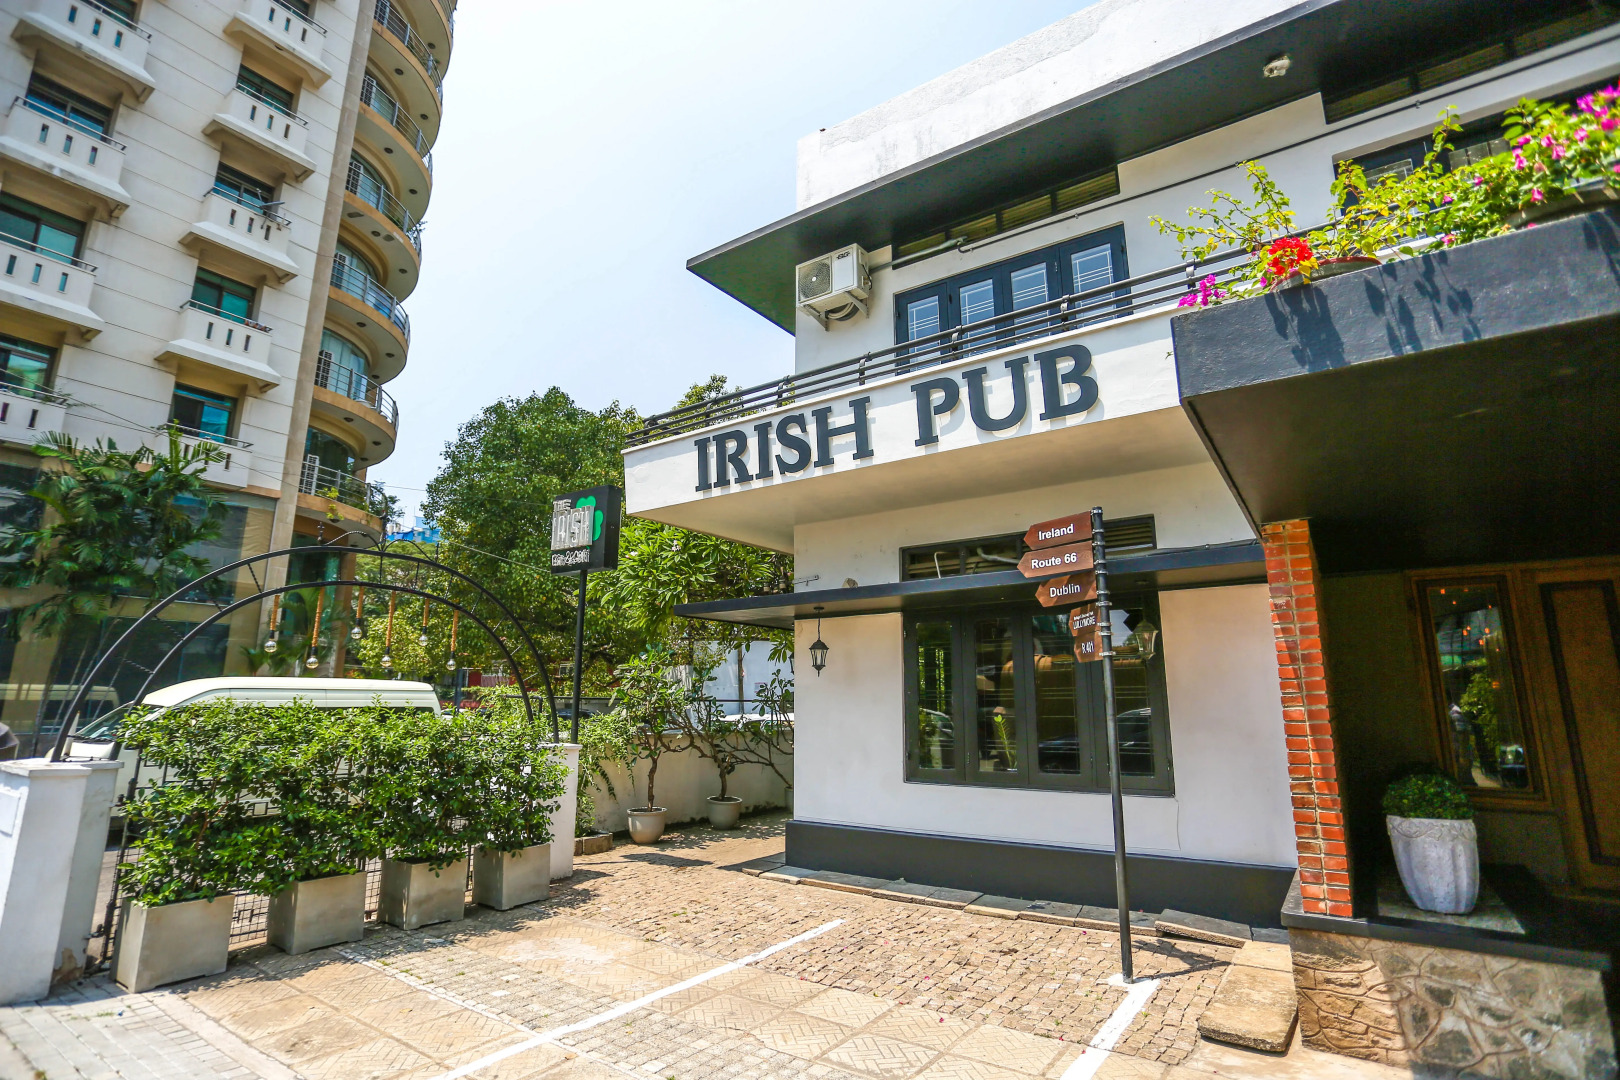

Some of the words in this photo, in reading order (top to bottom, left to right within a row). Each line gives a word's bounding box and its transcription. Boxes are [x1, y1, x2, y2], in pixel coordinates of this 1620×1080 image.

[694, 396, 874, 493] IRISH
[910, 344, 1099, 448] PUB
[552, 499, 572, 512] THE
[550, 505, 595, 550] IRISH
[1038, 523, 1075, 541] Ireland
[1031, 556, 1062, 569] Route
[1064, 552, 1078, 564] 66
[1049, 583, 1081, 598] Dublin
